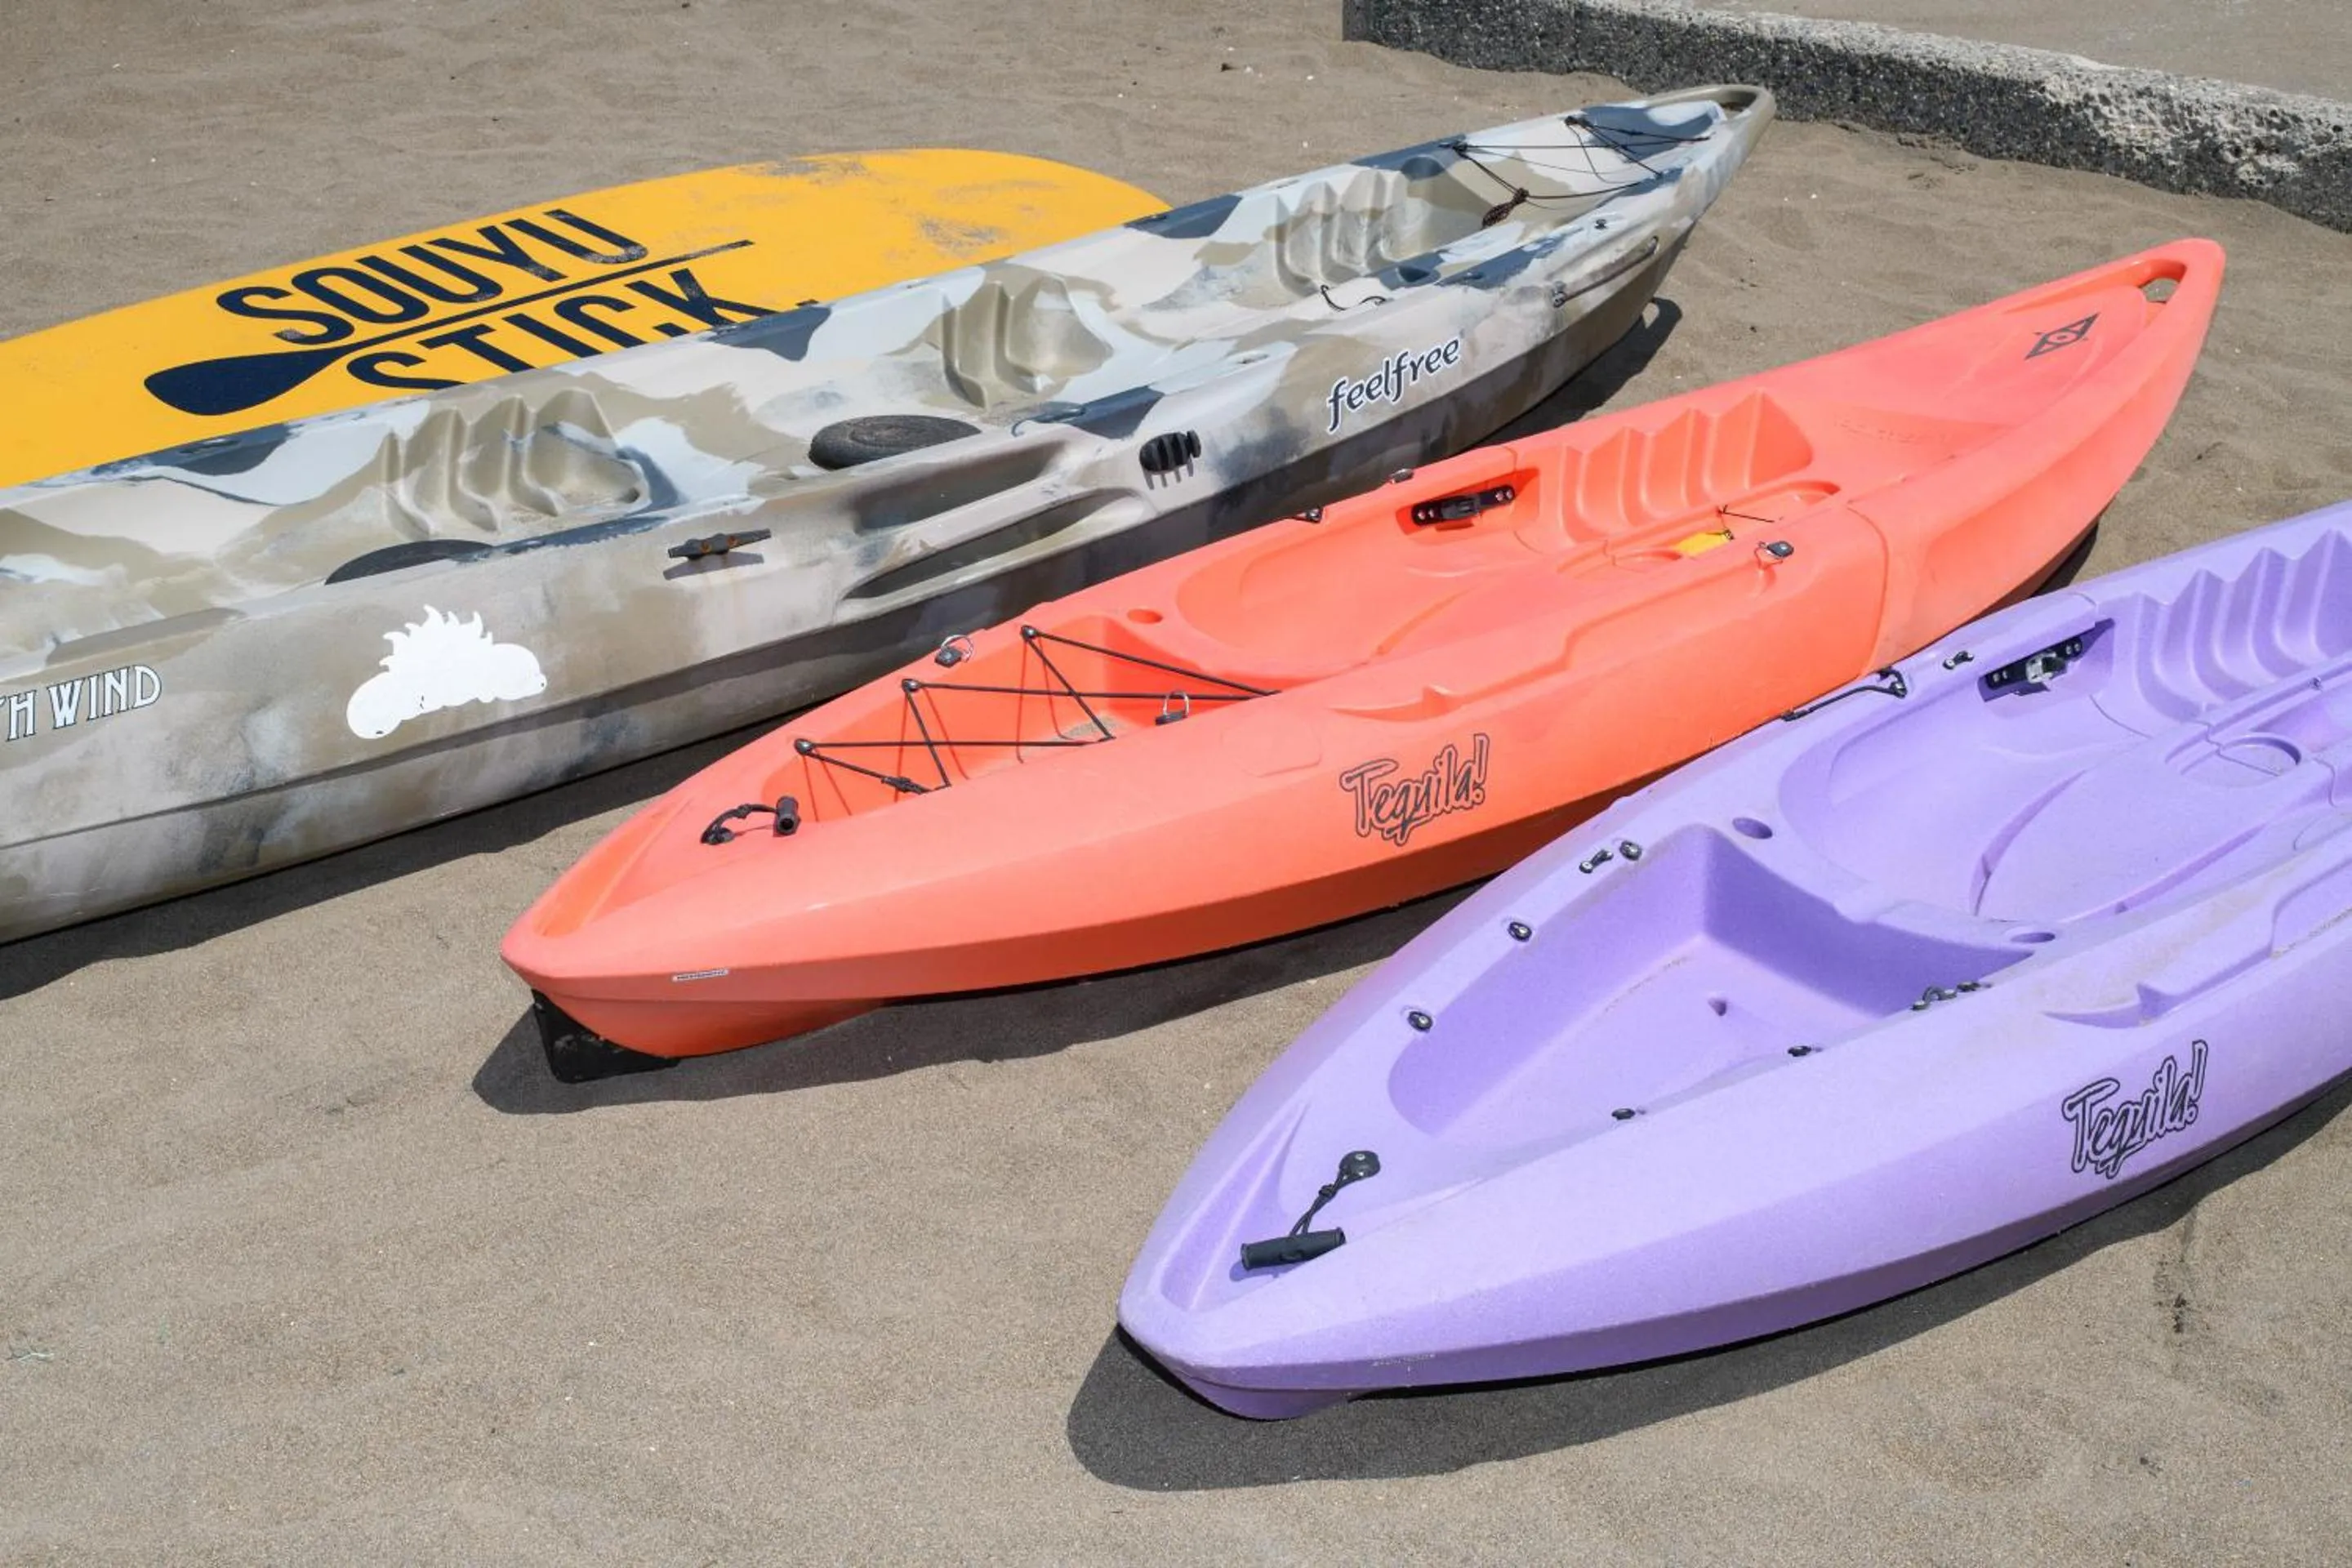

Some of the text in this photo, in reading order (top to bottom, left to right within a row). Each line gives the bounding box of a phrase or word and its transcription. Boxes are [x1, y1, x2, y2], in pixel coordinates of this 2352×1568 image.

[216, 208, 649, 345] SOUYU
[1327, 336, 1460, 434] feelfree
[46, 664, 163, 729] WIND
